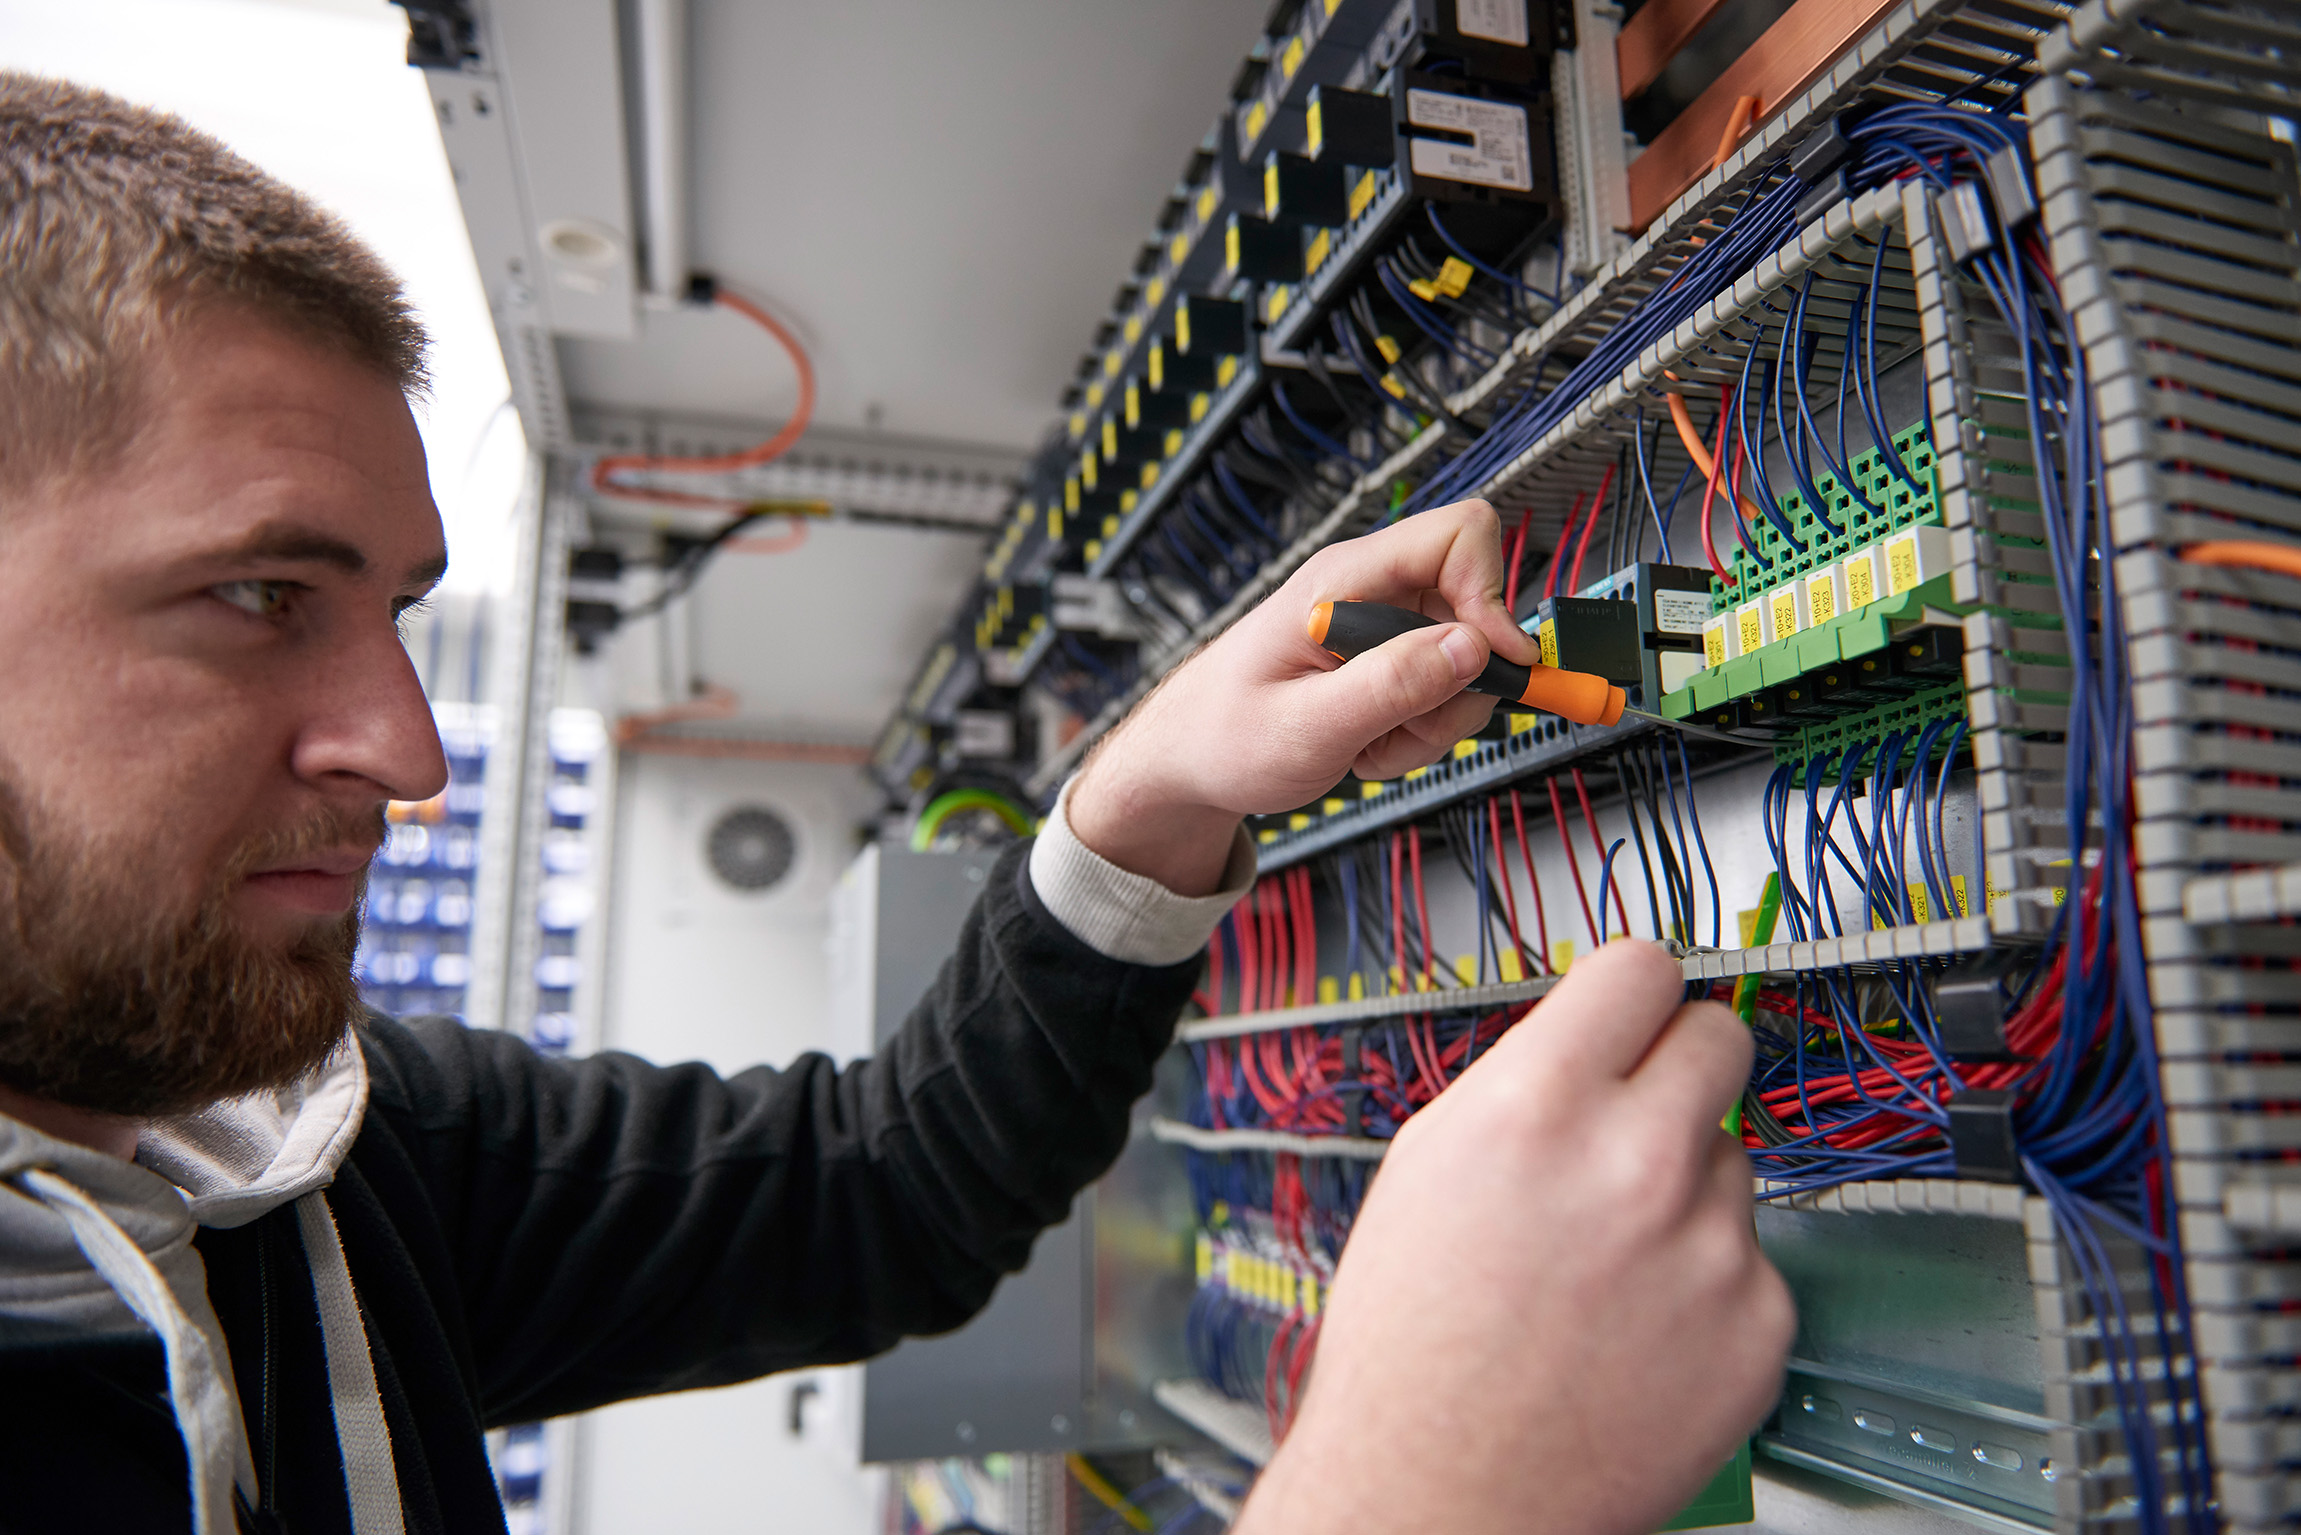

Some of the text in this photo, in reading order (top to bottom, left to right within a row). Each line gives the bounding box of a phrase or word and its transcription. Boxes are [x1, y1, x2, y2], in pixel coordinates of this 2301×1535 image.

[1892, 554, 1903, 589] =30+E2
[1822, 590, 1831, 616] -K323
[1850, 572, 1860, 606] =20+E2
[1775, 607, 1784, 639] =10+E2
[1784, 607, 1793, 632] -K322
[1813, 591, 1822, 625] =10+E2
[1542, 631, 1550, 662] =30+E2
[1741, 622, 1750, 653] =10+E2
[1750, 622, 1758, 646] -K321
[1917, 896, 1926, 920] -K321
[1956, 889, 1966, 914] -K322
